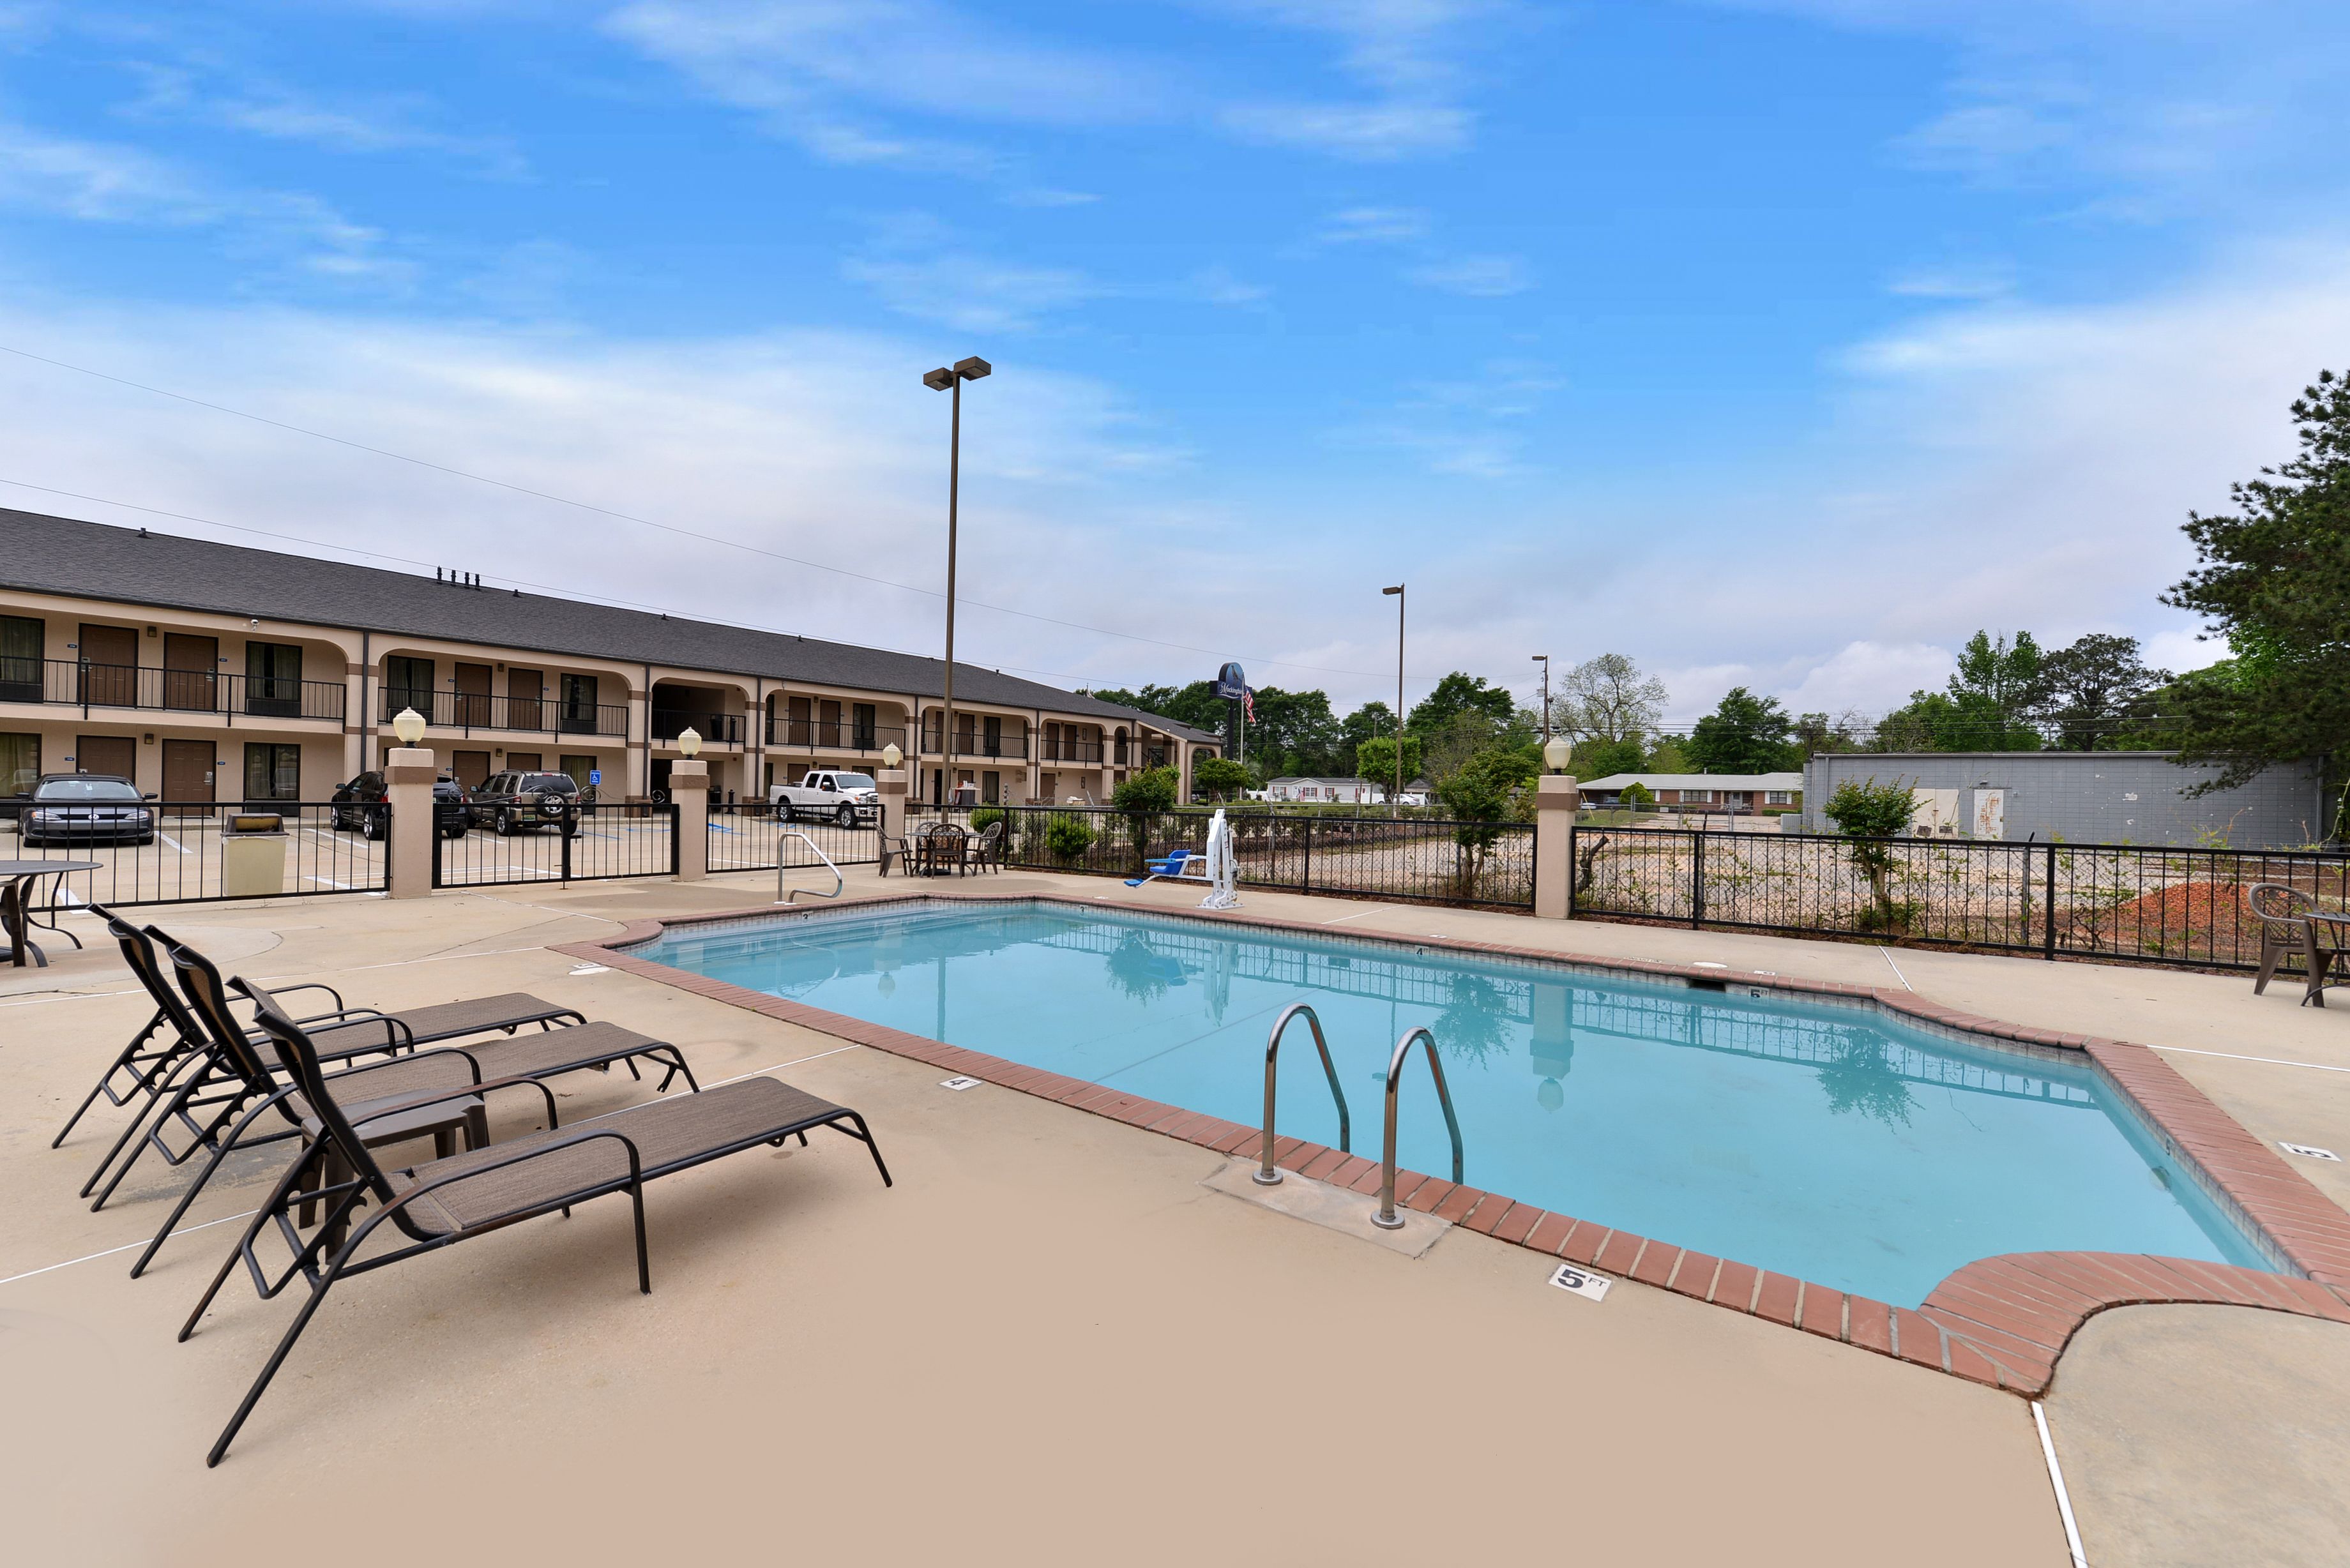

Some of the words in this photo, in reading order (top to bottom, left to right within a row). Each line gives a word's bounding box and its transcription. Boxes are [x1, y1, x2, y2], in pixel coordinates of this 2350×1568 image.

[1751, 989, 1761, 998] 5
[2292, 1148, 2331, 1159] 5
[1558, 1269, 1587, 1288] 5
[1588, 1278, 1607, 1286] FT
